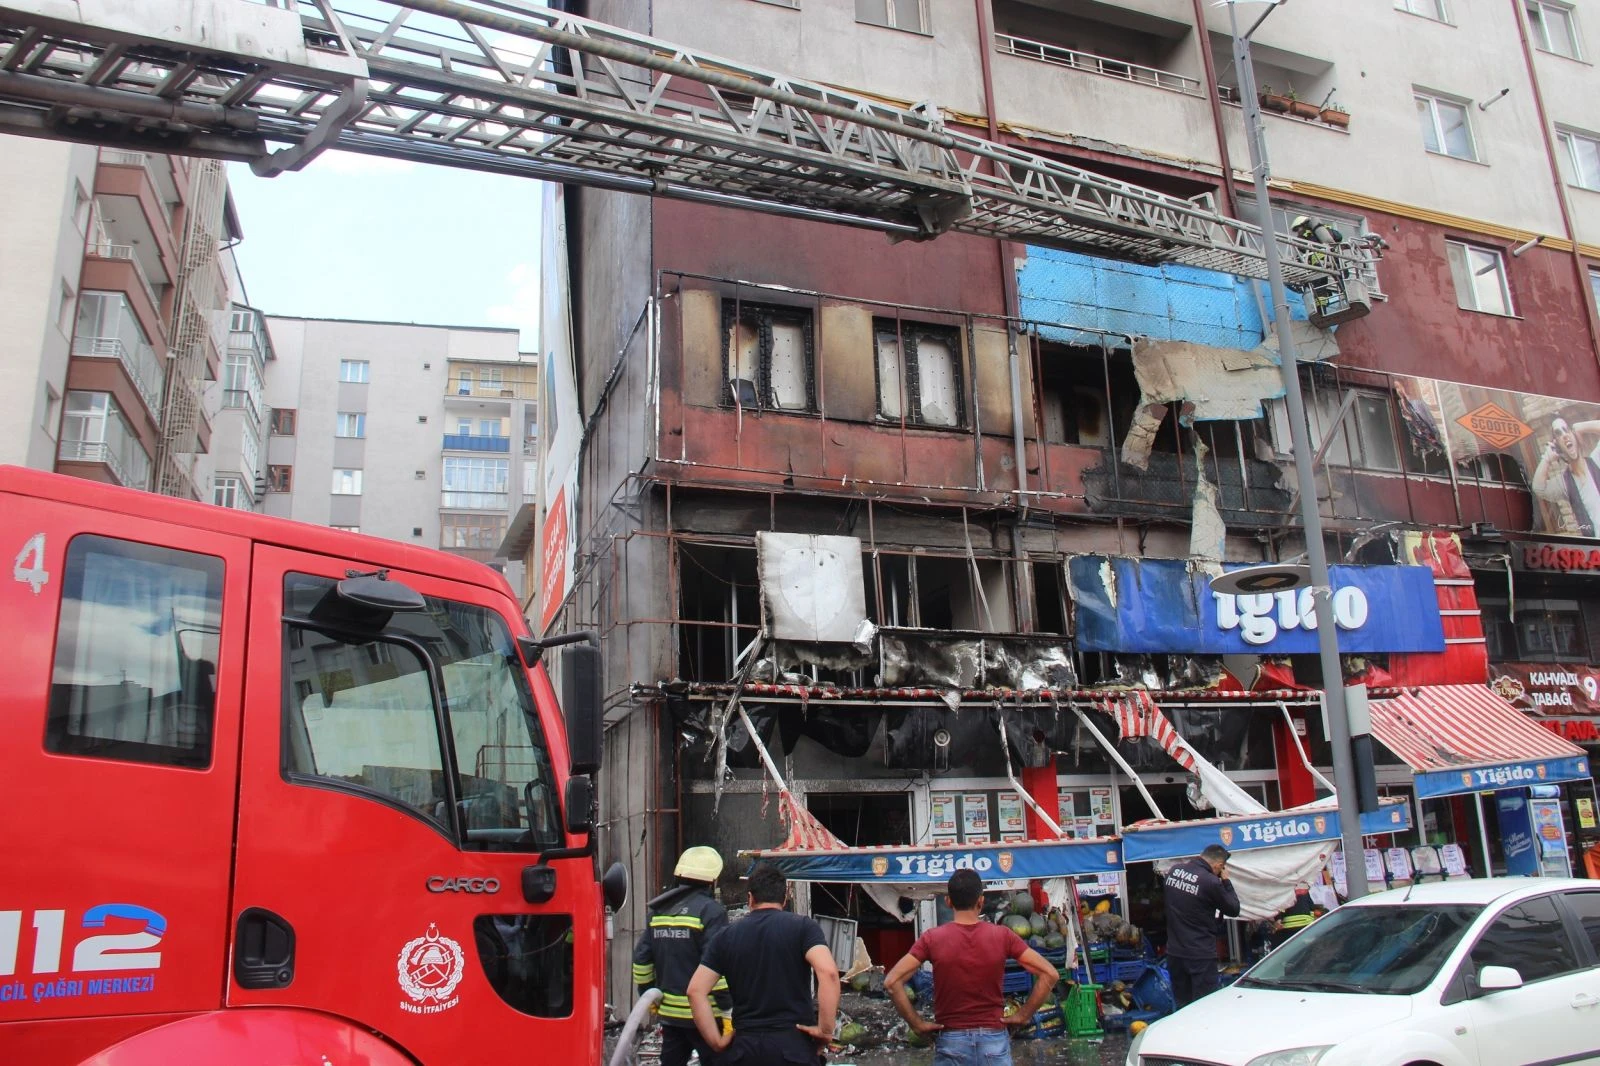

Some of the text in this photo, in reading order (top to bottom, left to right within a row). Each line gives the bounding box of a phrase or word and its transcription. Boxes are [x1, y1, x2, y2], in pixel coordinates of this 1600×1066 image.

[1471, 417, 1521, 435] SCOOTER
[13, 532, 49, 595] 4
[1532, 687, 1573, 706] TABAĞI
[1475, 765, 1534, 785] Yiğido
[1238, 820, 1310, 843] Yiğido
[896, 854, 992, 877] Yiğido
[1172, 868, 1199, 883] SİVAS
[426, 876, 500, 893] CARGO
[32, 977, 83, 1003] ÇAĞRI
[88, 973, 155, 995] MERKEZİ
[400, 994, 460, 1015] SİVAS İTFAİYESİ
